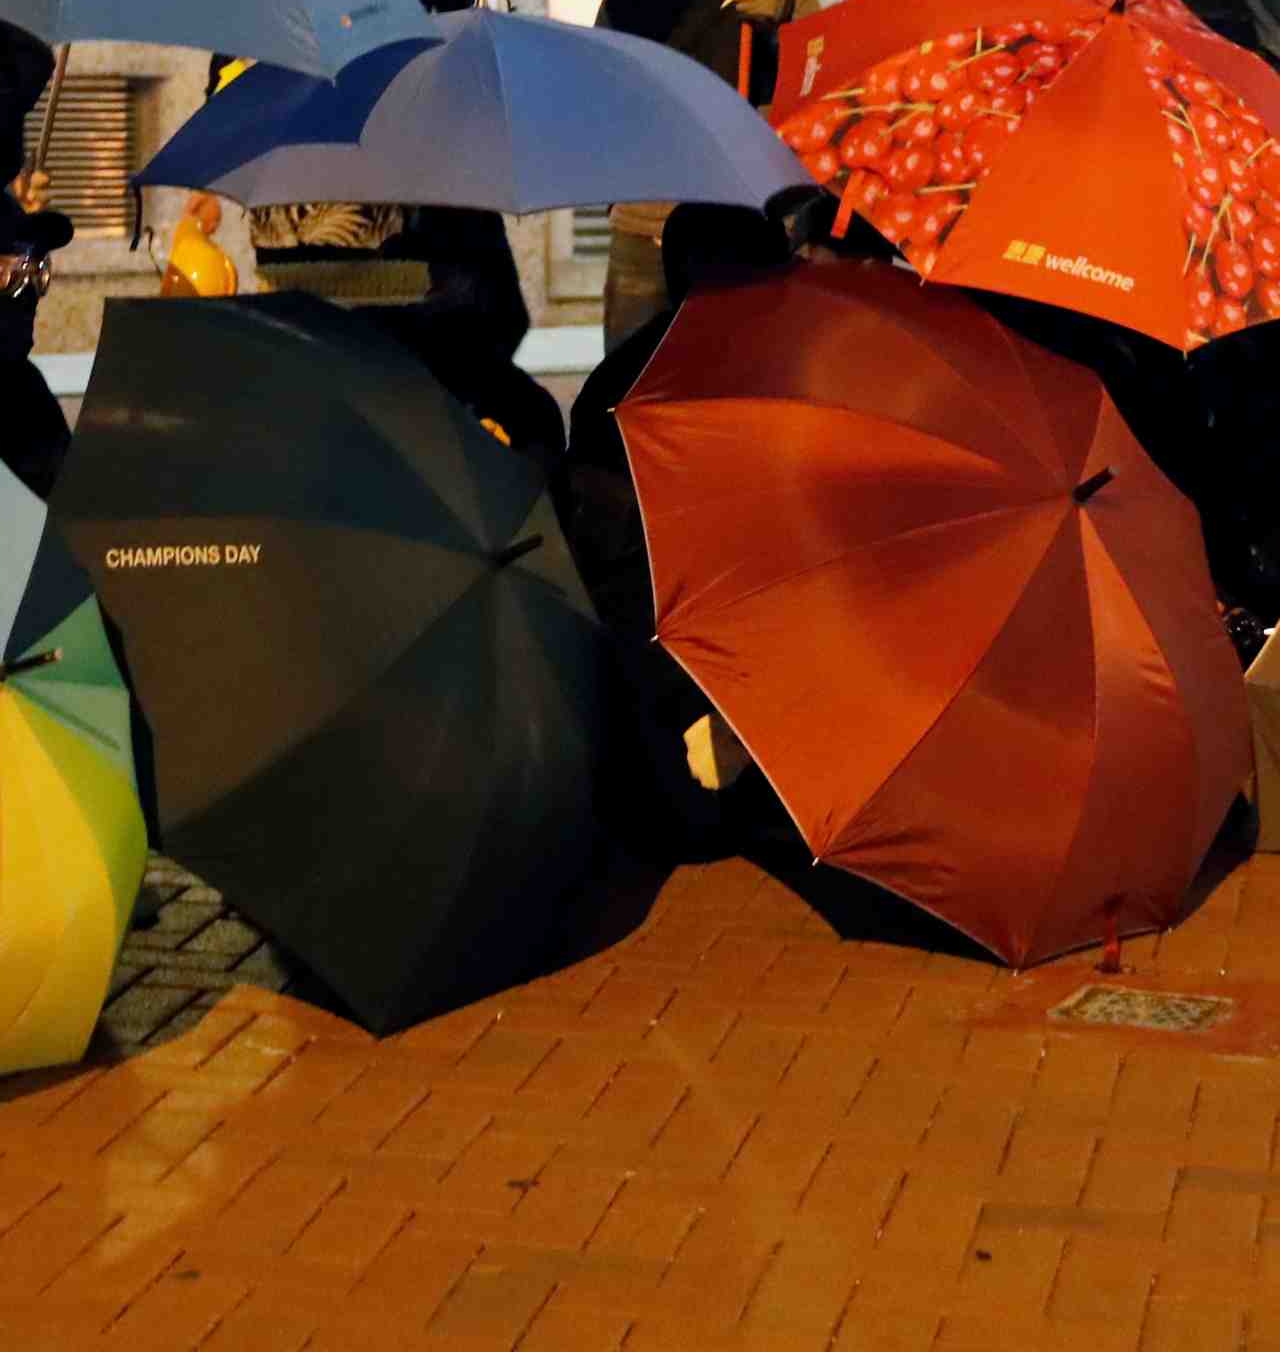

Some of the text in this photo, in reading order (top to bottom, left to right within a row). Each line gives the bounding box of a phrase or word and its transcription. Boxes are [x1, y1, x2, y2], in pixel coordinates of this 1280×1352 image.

[1045, 253, 1135, 292] wellcome
[105, 544, 261, 568] CHAMPIONS DAY
